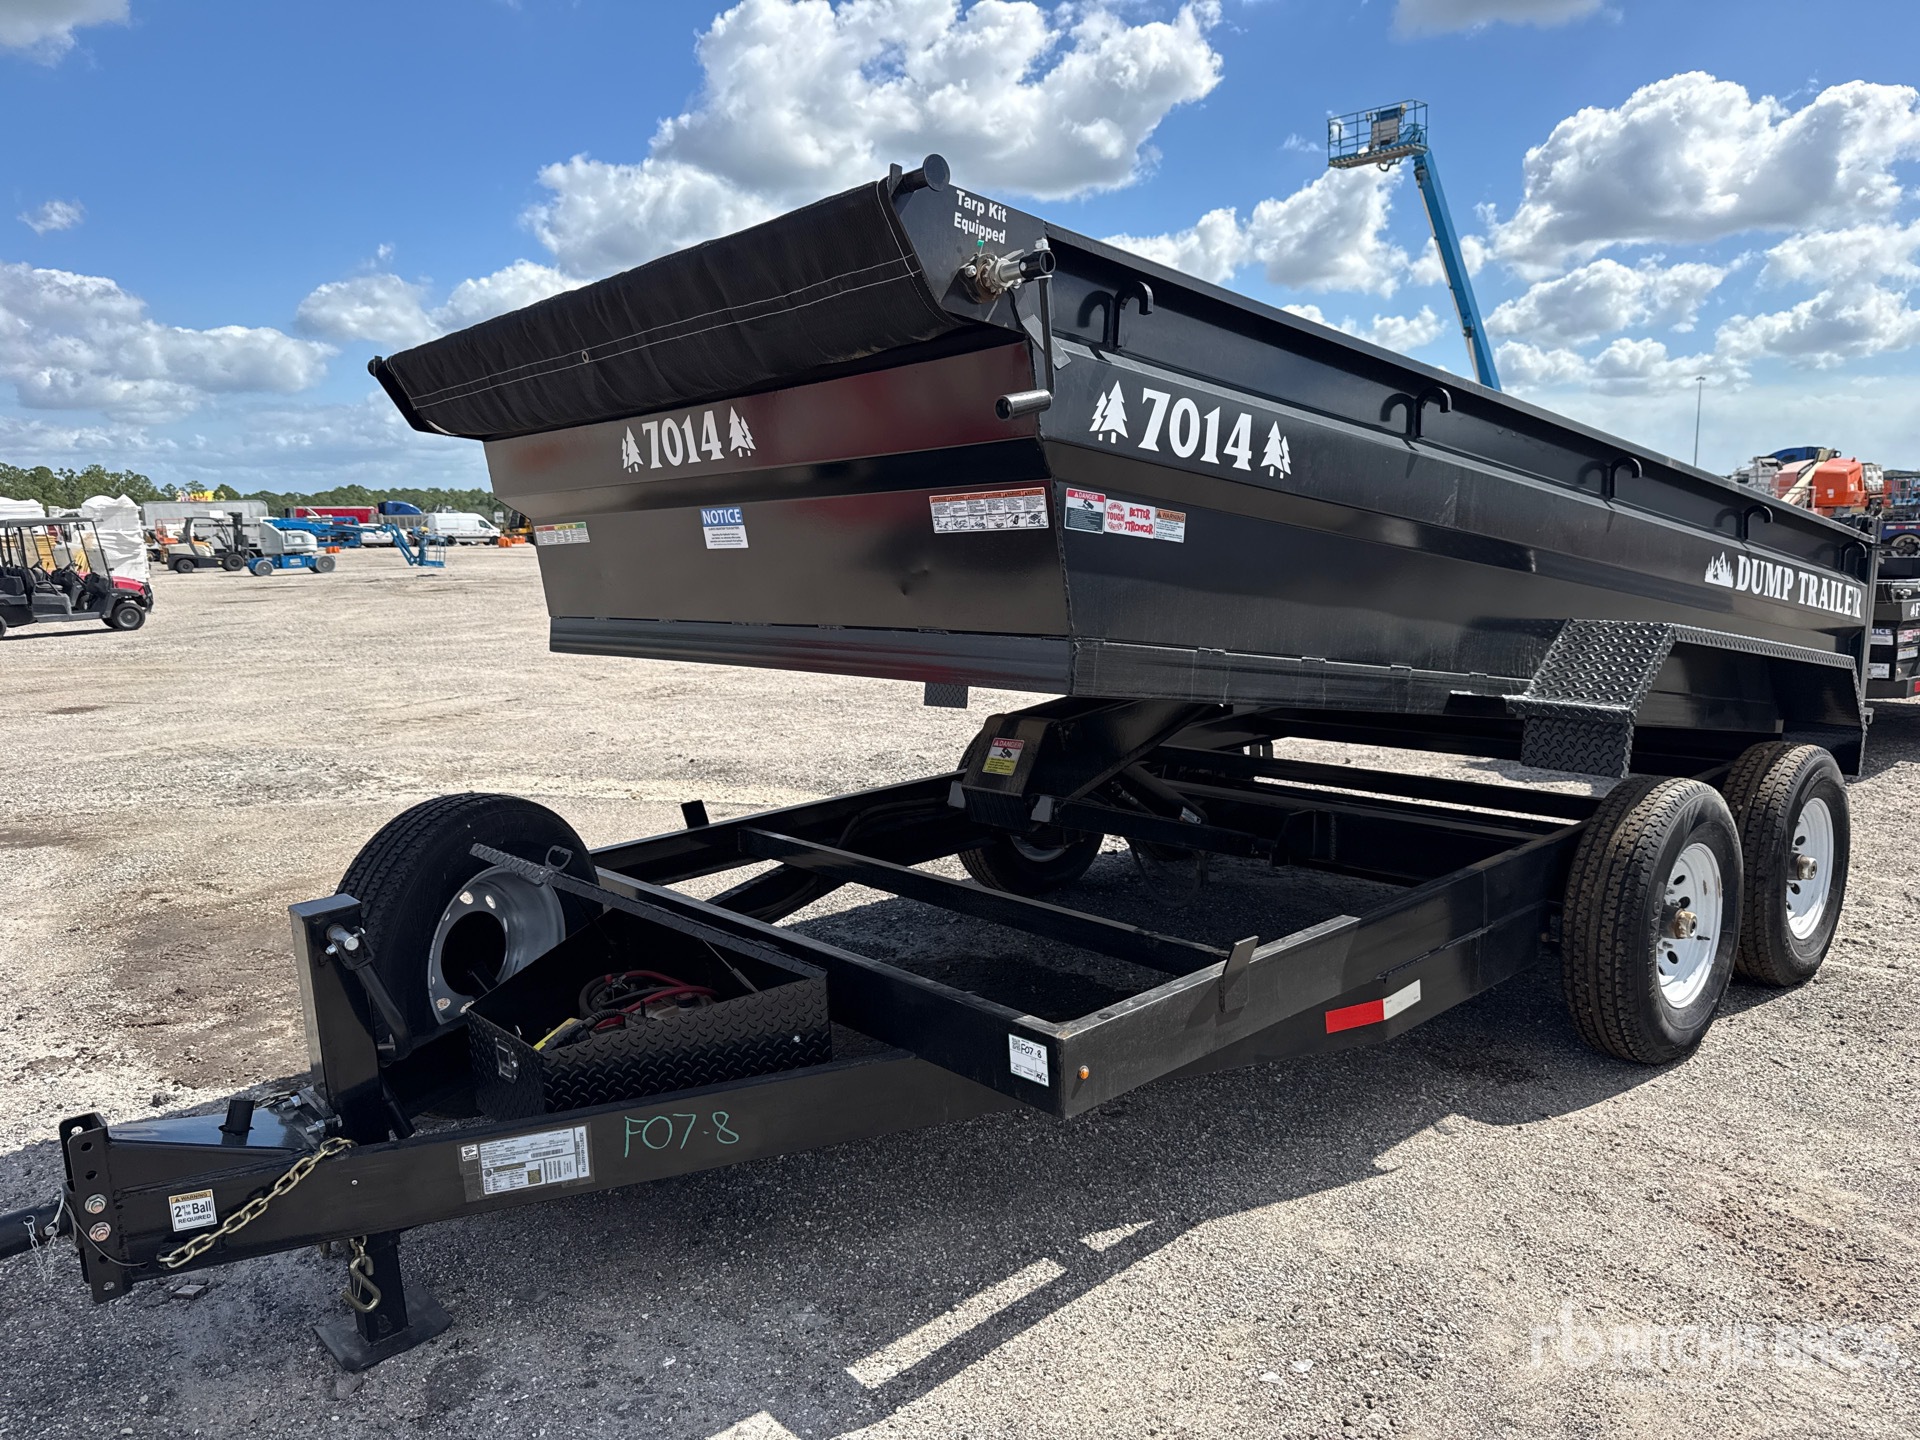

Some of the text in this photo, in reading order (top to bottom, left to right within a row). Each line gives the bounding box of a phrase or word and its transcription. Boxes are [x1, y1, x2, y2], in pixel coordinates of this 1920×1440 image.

[956, 190, 1007, 223] Tarp Kit
[953, 212, 1006, 244] Equipped
[1138, 387, 1252, 471] 7014
[642, 410, 725, 469] 7014
[1078, 493, 1099, 501] DANGER
[702, 508, 742, 525] NOTICE
[1106, 511, 1125, 523] TOUGH
[1129, 507, 1151, 520] BETTER
[1162, 512, 1184, 521] WARNING
[1124, 520, 1153, 534] STRONGER
[1735, 555, 1862, 618] DUMP TRAILER
[999, 740, 1022, 748] DANGER
[191, 1200, 212, 1215] Ball
[178, 1213, 211, 1223] REQUIRED
